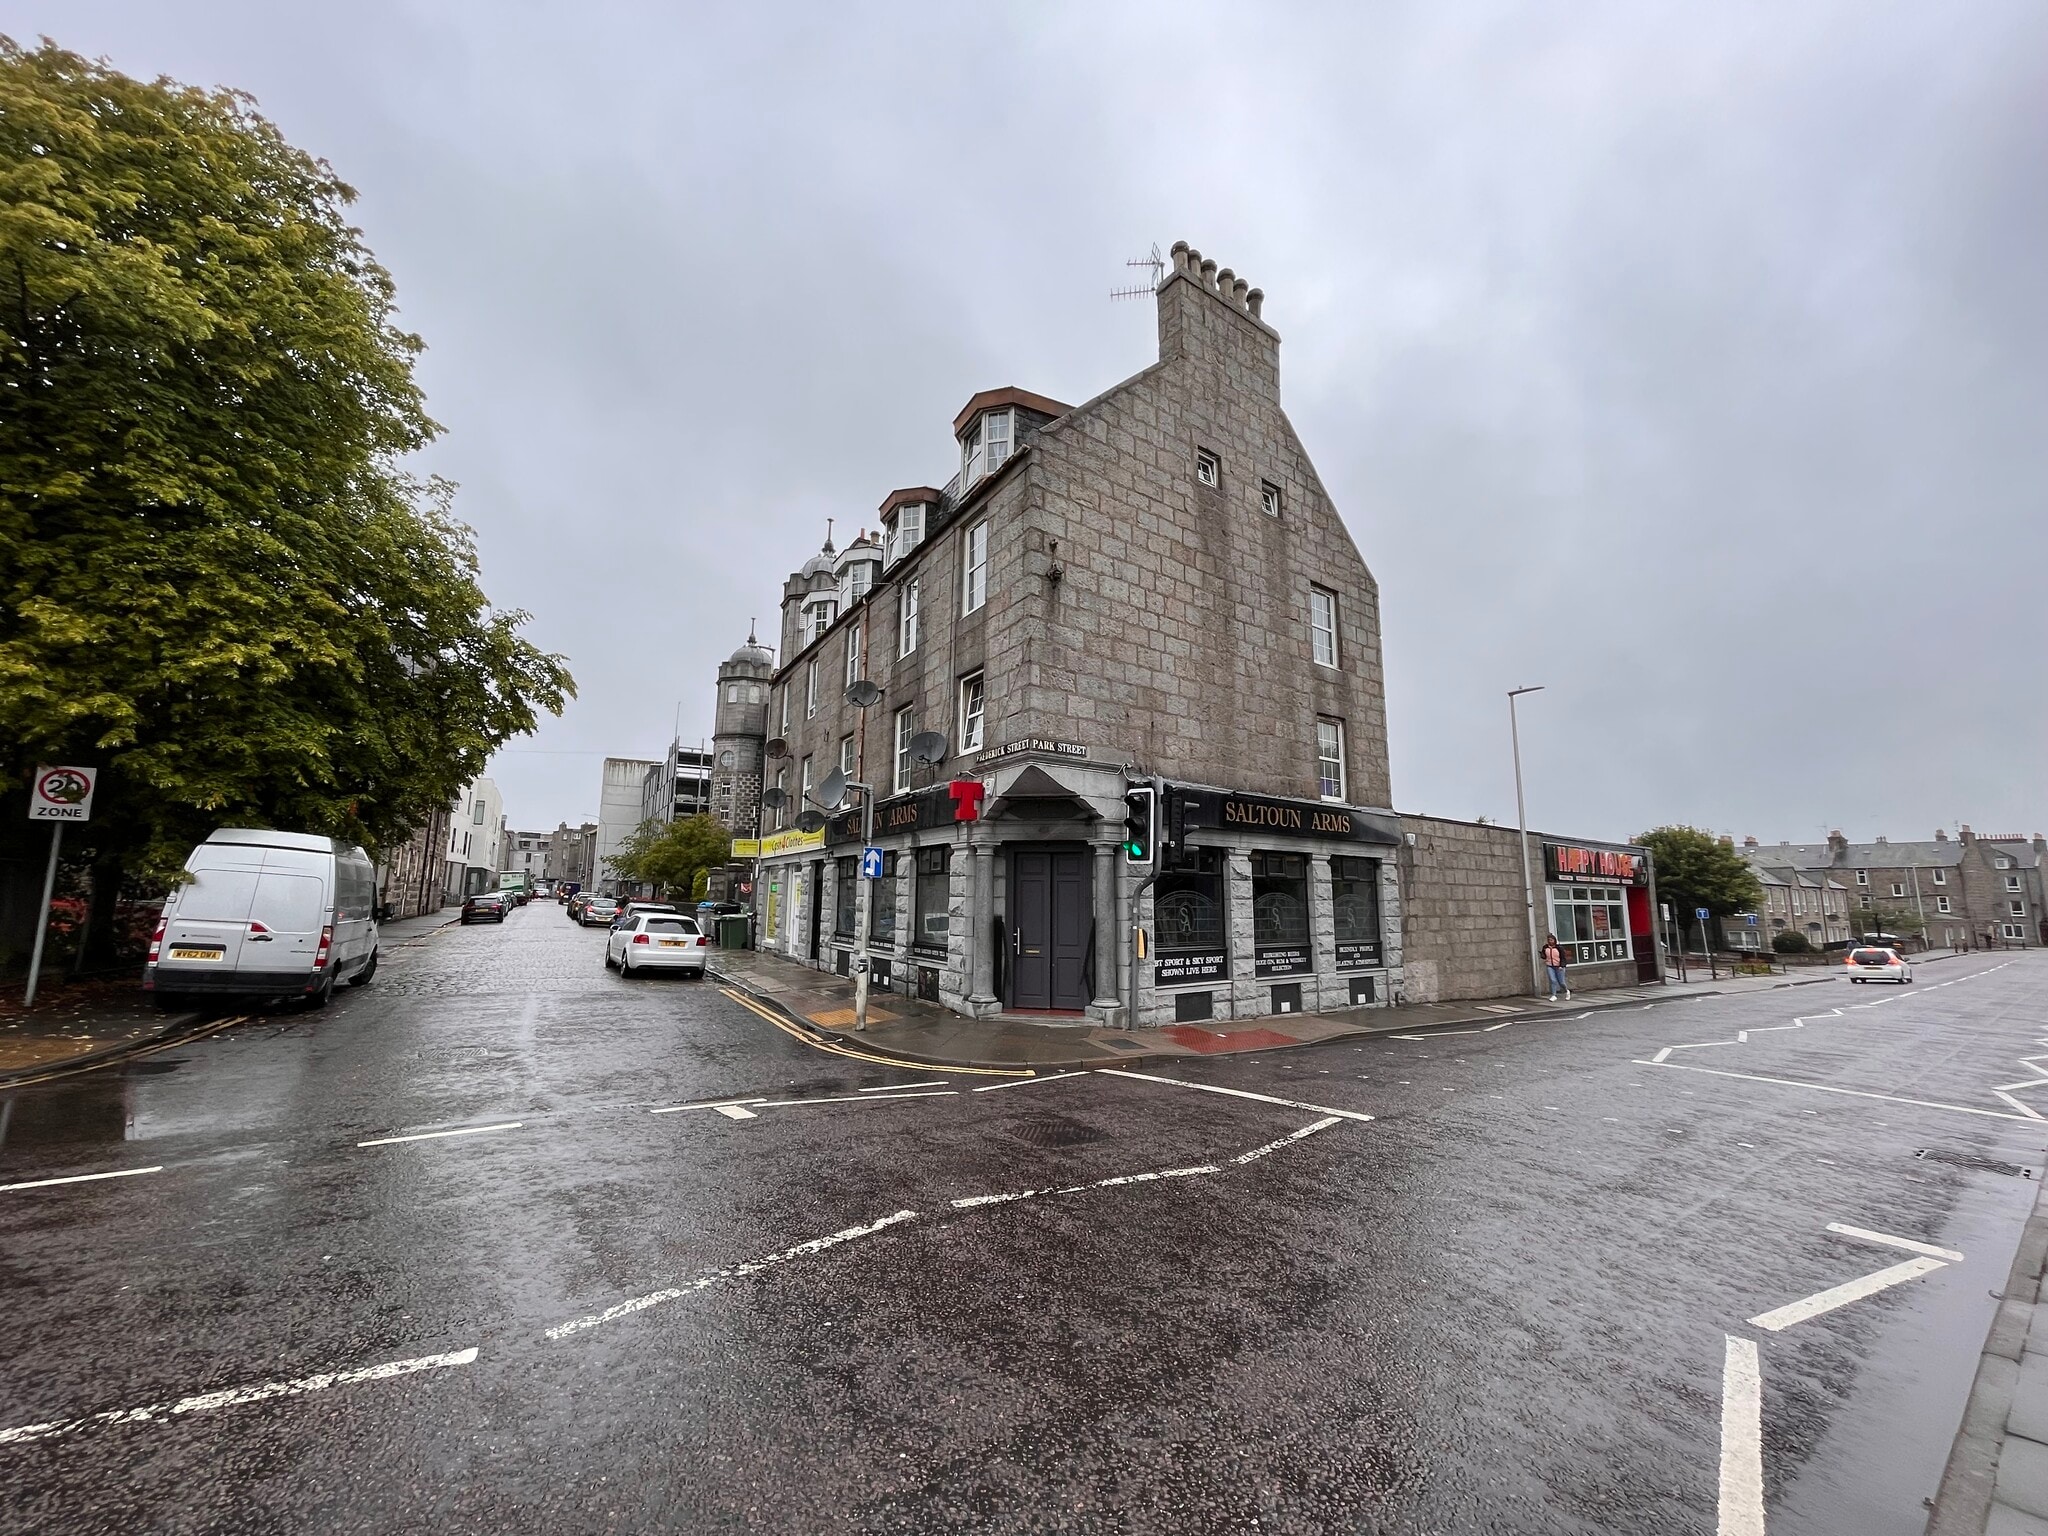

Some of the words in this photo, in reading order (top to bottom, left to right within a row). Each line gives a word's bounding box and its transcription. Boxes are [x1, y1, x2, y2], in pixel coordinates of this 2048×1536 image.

[1007, 739, 1030, 754] STREET
[1033, 739, 1056, 752] PARK
[1057, 743, 1087, 755] STREET
[37, 806, 83, 818] ZONE
[889, 803, 918, 827] ARMS
[1226, 801, 1302, 829] SALTOUN
[1311, 812, 1351, 833] ARMS
[1557, 846, 1597, 874] HAPPY
[1599, 851, 1634, 878] HOUSE
[1164, 958, 1185, 967] SPORT
[1185, 957, 1191, 965] &
[1192, 956, 1205, 965] SKY
[1205, 955, 1224, 964] SPORT
[1161, 967, 1185, 977] SHOWN
[1186, 966, 1200, 975] LIVE
[1201, 965, 1218, 974] HERE
